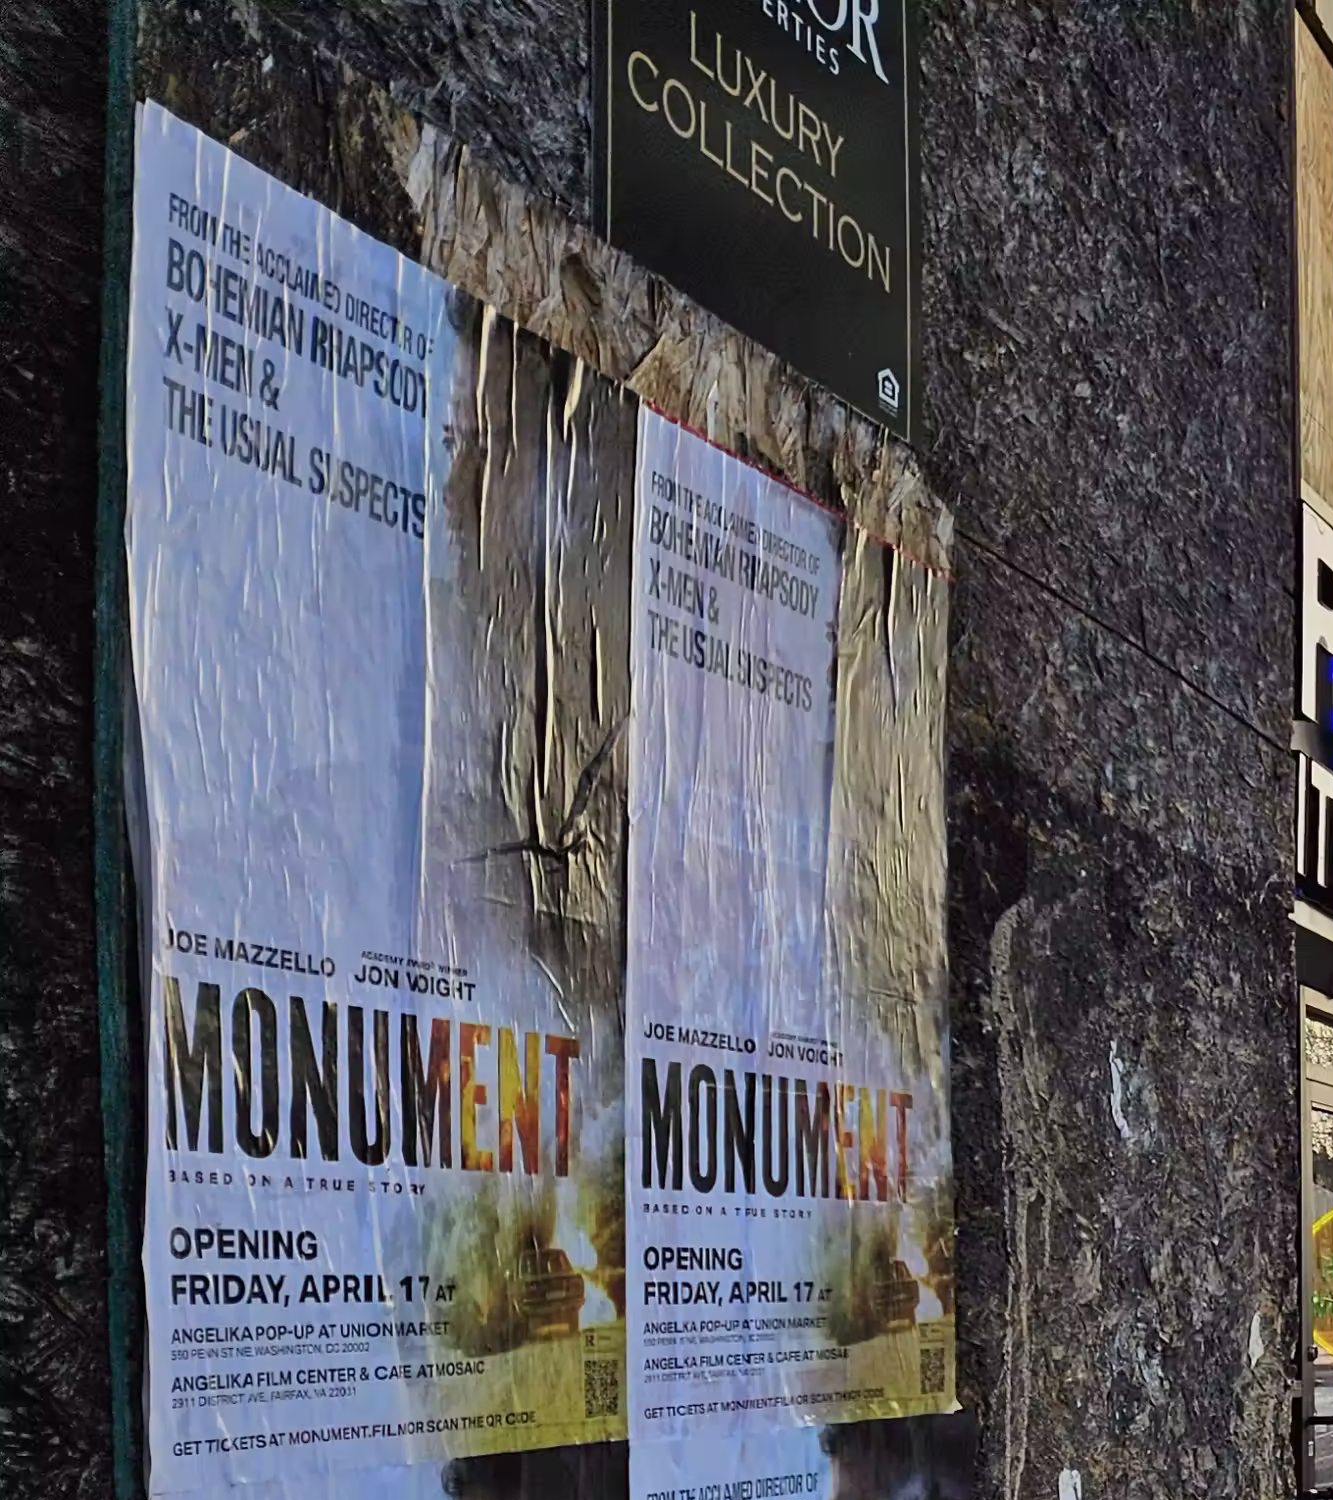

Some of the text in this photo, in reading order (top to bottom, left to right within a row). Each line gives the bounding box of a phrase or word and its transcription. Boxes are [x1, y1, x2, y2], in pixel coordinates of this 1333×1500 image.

[690, 10, 844, 178] LUXURY
[628, 51, 890, 293] COLLECTION
[167, 237, 303, 356] BOHEMIAN
[164, 306, 279, 411] X-MEN &
[163, 377, 302, 487] THE USUAL
[649, 557, 719, 625] X-MEN &
[648, 609, 679, 658] THE
[215, 937, 335, 977] MAZZELLO
[355, 964, 399, 988] JON
[644, 1022, 674, 1042] JOE
[679, 1027, 756, 1054] MAZZELLO
[768, 1042, 794, 1060] JON
[163, 975, 581, 1178] MONUMENT
[641, 1057, 913, 1204] MONUMENT
[284, 1176, 355, 1191] A TRUE
[643, 1203, 812, 1220] BASED ON A STORY
[170, 1227, 318, 1260] OPENING
[644, 1247, 742, 1270] OPENING
[171, 1274, 393, 1308] FRIDAY, APRIL
[644, 1281, 813, 1306] FRIDAY, APRIL 17
[171, 1323, 393, 1344] ANGELIKA POP-UP AT UNION
[700, 1318, 785, 1332] POP-UP UNION
[221, 1348, 233, 1357] ST
[700, 1354, 723, 1368] FILM
[172, 1364, 434, 1392] ANGELIKA FILM CENTER & AT
[172, 1398, 197, 1409] 2911
[644, 1408, 663, 1419] GET
[173, 1416, 483, 1456] GET TICKETS AT SCAN THE
[756, 1474, 802, 1498] DIRECTOR
[806, 1473, 818, 1492] OF
